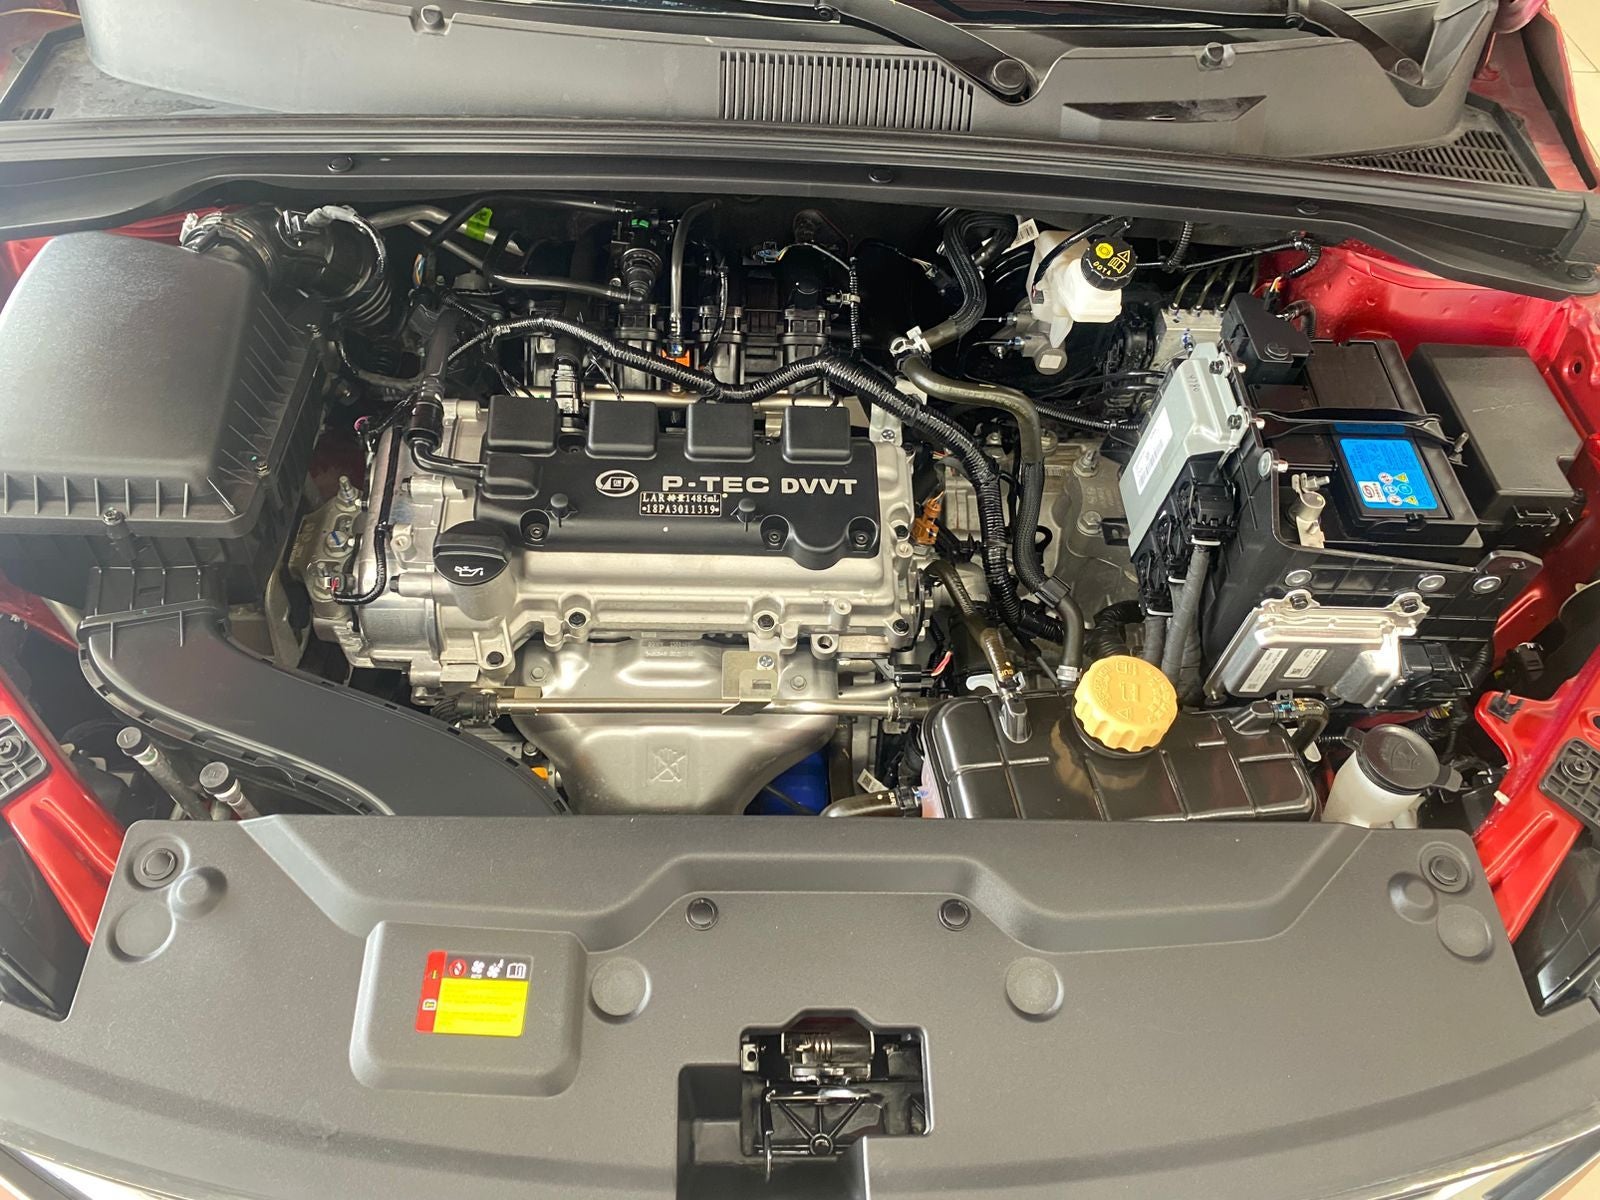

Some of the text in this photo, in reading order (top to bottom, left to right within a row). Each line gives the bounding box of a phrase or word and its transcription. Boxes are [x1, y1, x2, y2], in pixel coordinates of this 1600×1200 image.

[662, 476, 857, 494] P-TEC DVVT
[642, 493, 665, 503] LAR
